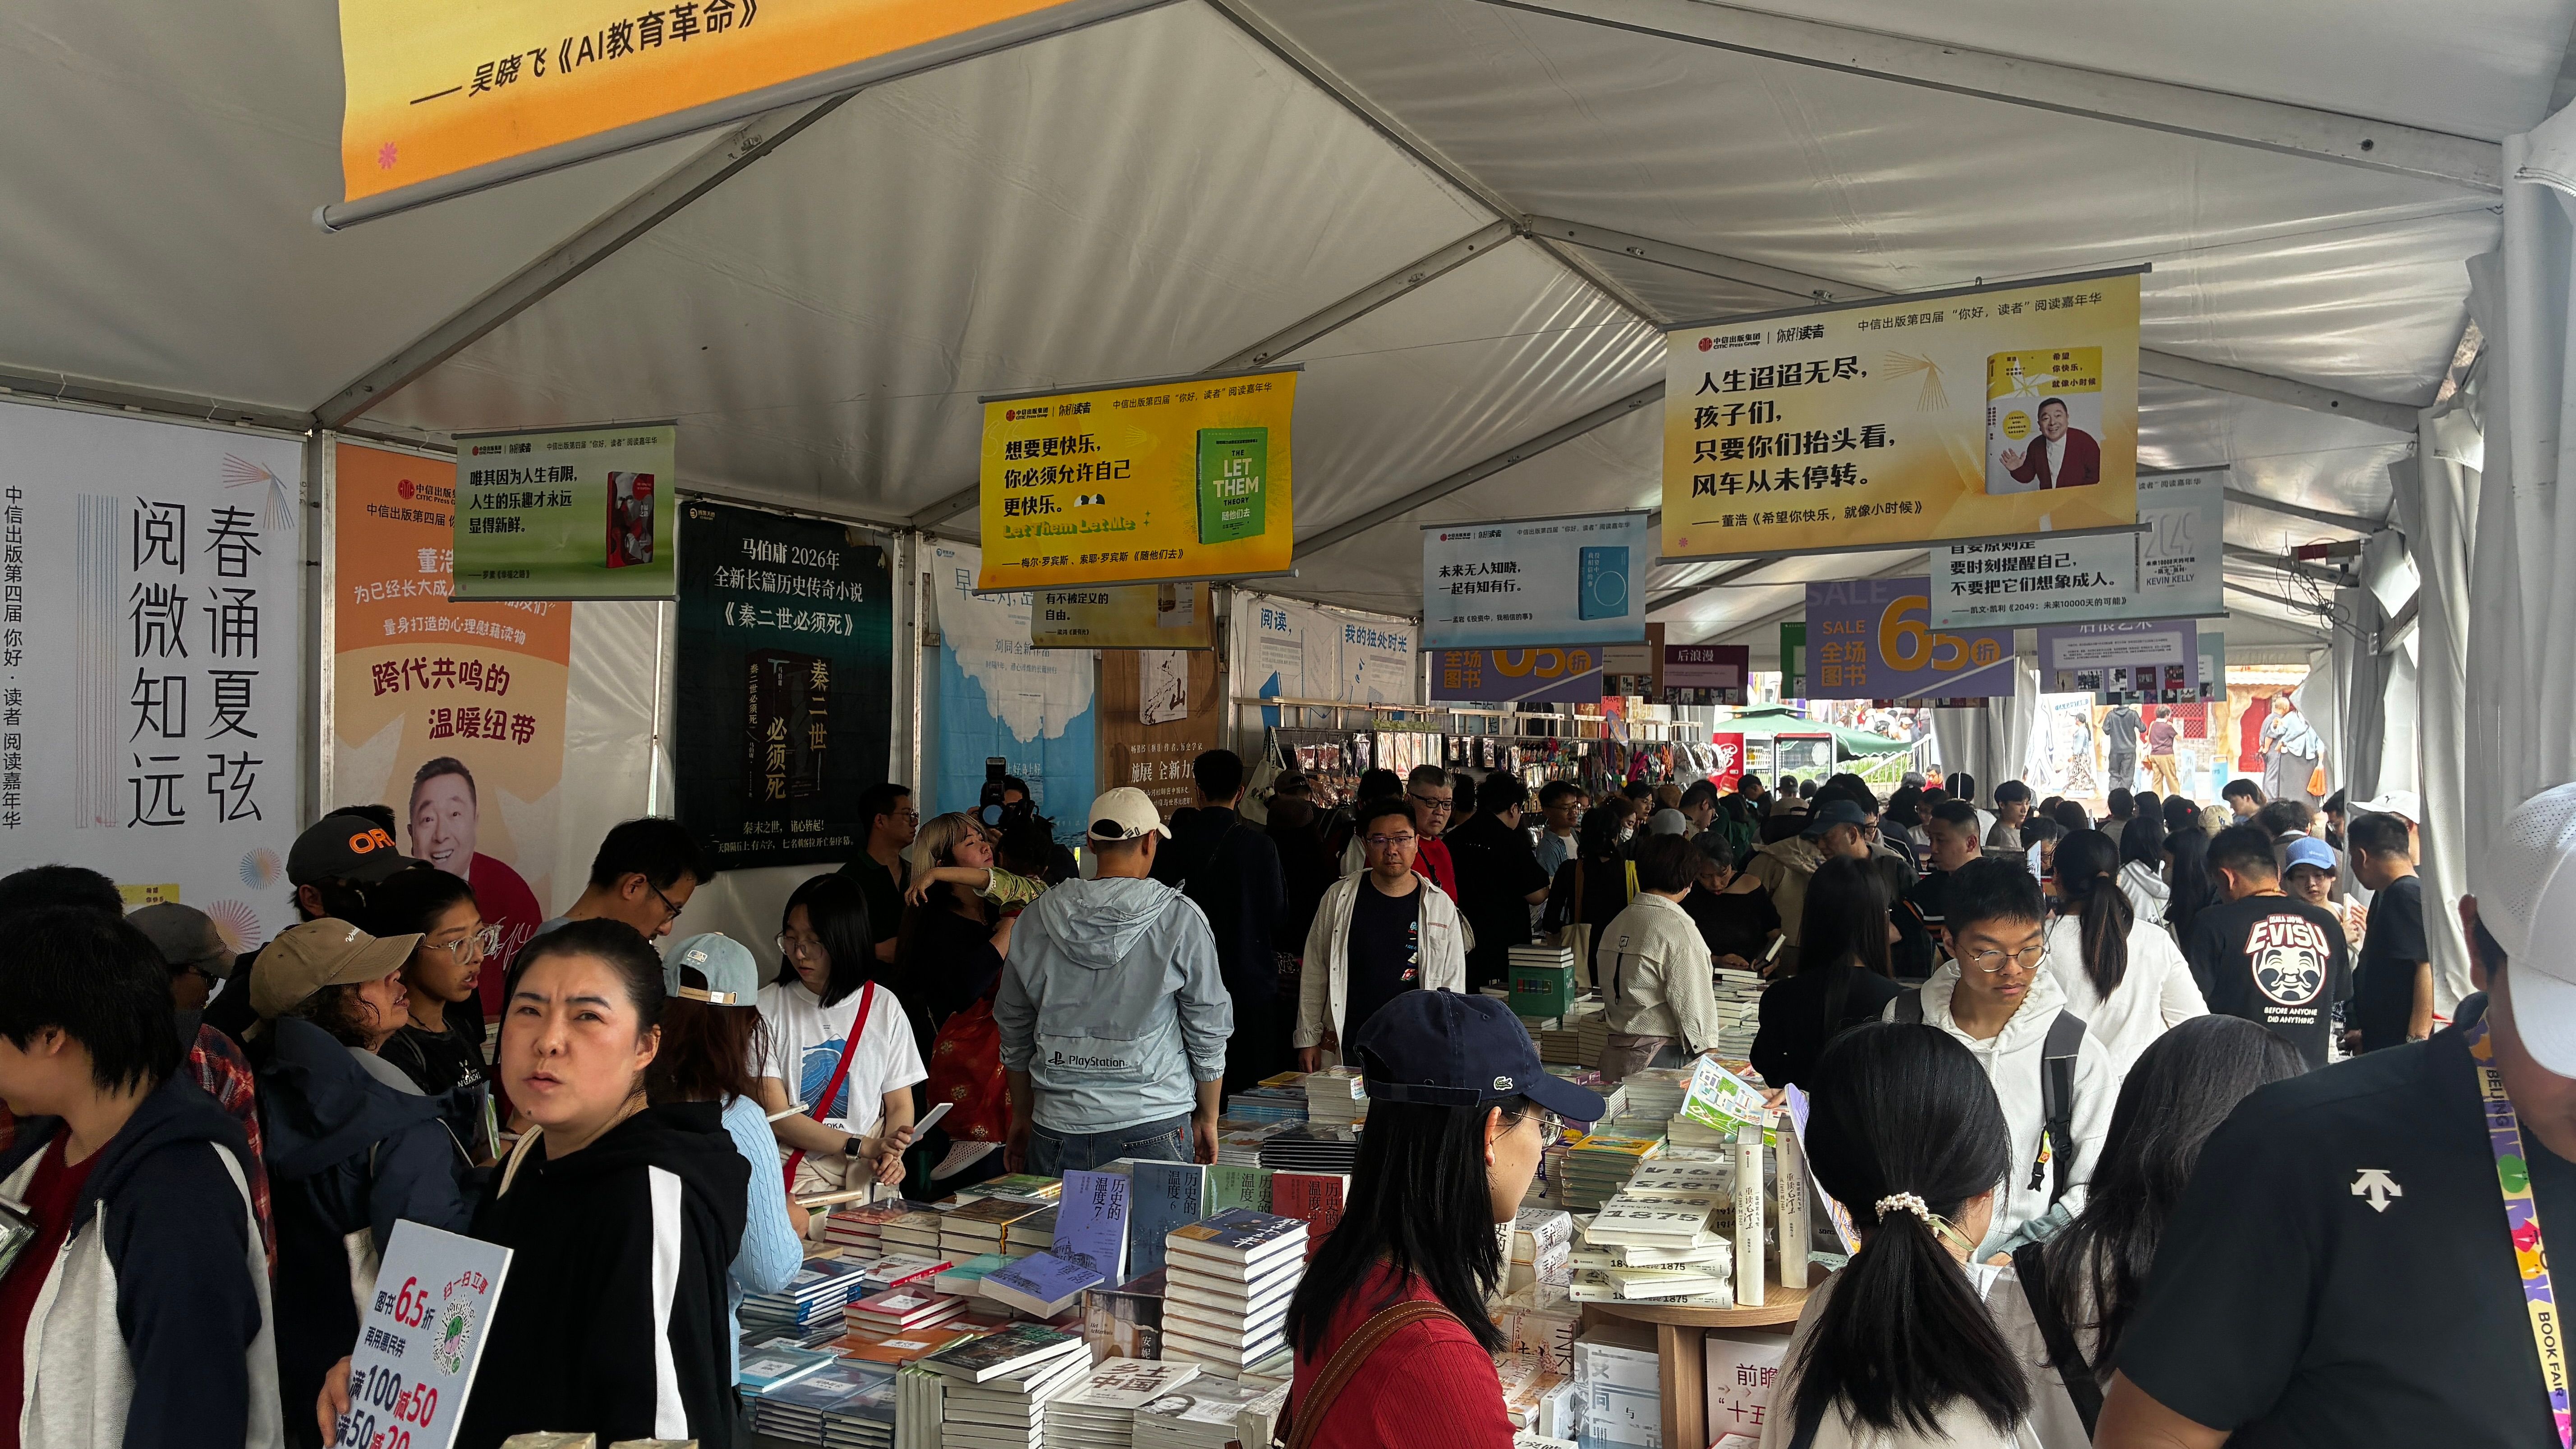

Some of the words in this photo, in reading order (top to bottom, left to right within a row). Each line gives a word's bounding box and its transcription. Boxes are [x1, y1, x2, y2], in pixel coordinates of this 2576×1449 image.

[1694, 400, 1781, 431] 孩子们，
[1005, 432, 1101, 461] 想要更快乐，
[1694, 423, 1895, 465] 只要你们抬头看，
[1004, 459, 1131, 490] 你必须允许自己
[1224, 457, 1252, 478] LET
[416, 484, 455, 498] 中信出版
[1213, 477, 1259, 499] THEM
[1692, 462, 1869, 500] 风车从未停转。
[469, 490, 572, 511] 人生的乐趣才永远
[1004, 494, 1063, 517] 更快乐。
[1224, 497, 1249, 506] THEORY
[367, 502, 445, 526] 中信出版第四届
[469, 516, 525, 534] 显得新鲜。
[741, 538, 787, 565] 马伯庸
[791, 546, 840, 571] 2026年
[1439, 561, 1521, 578] 未来无人知晓，
[2147, 577, 2169, 586] KEVIN
[2172, 574, 2194, 583] KELLY
[713, 565, 863, 603] 全新长篇历史传奇小说
[1439, 579, 1521, 595] 一起有知有行。
[1806, 580, 1889, 607] SALE
[1950, 572, 2115, 596] 不要把它们想象成人。
[1046, 593, 1109, 604] 有不被定义的
[725, 601, 854, 637] 《秦二世必须死》
[1045, 609, 1071, 621] 自由。
[1345, 624, 1408, 653] 我的独处时光
[1823, 620, 1865, 635] SALE
[128, 496, 189, 828] 阅微知远
[202, 505, 263, 823] 春诵夏弦
[1444, 650, 1482, 667] 全场
[1678, 650, 1714, 662] 后浪漫
[1820, 641, 1866, 663] 全场
[372, 657, 510, 696] 跨代共鸣的
[1444, 669, 1481, 689] 图书
[1821, 665, 1866, 686] 图书
[808, 658, 830, 752] 秦二世
[429, 707, 536, 745] 温暖纽带
[765, 716, 787, 802] 必须死
[1069, 1055, 1125, 1068] PlayStation
[2486, 1069, 2510, 1127] BEIJING
[1107, 1179, 1126, 1220] 历史的
[1184, 1172, 1197, 1215] 历史的
[1240, 1173, 1254, 1209] 温度
[1604, 1210, 1700, 1221] 1875
[1661, 1263, 1686, 1271] 1875
[1141, 1336, 1151, 1358] 安妮
[2538, 1311, 2558, 1360] BOOK
[2548, 1362, 2563, 1398] FAIR
[1101, 1363, 1171, 1378] 乡土
[1736, 1363, 1778, 1389] 前瞻
[1090, 1375, 1163, 1392] 中国
[348, 1365, 437, 1428] 满100减50
